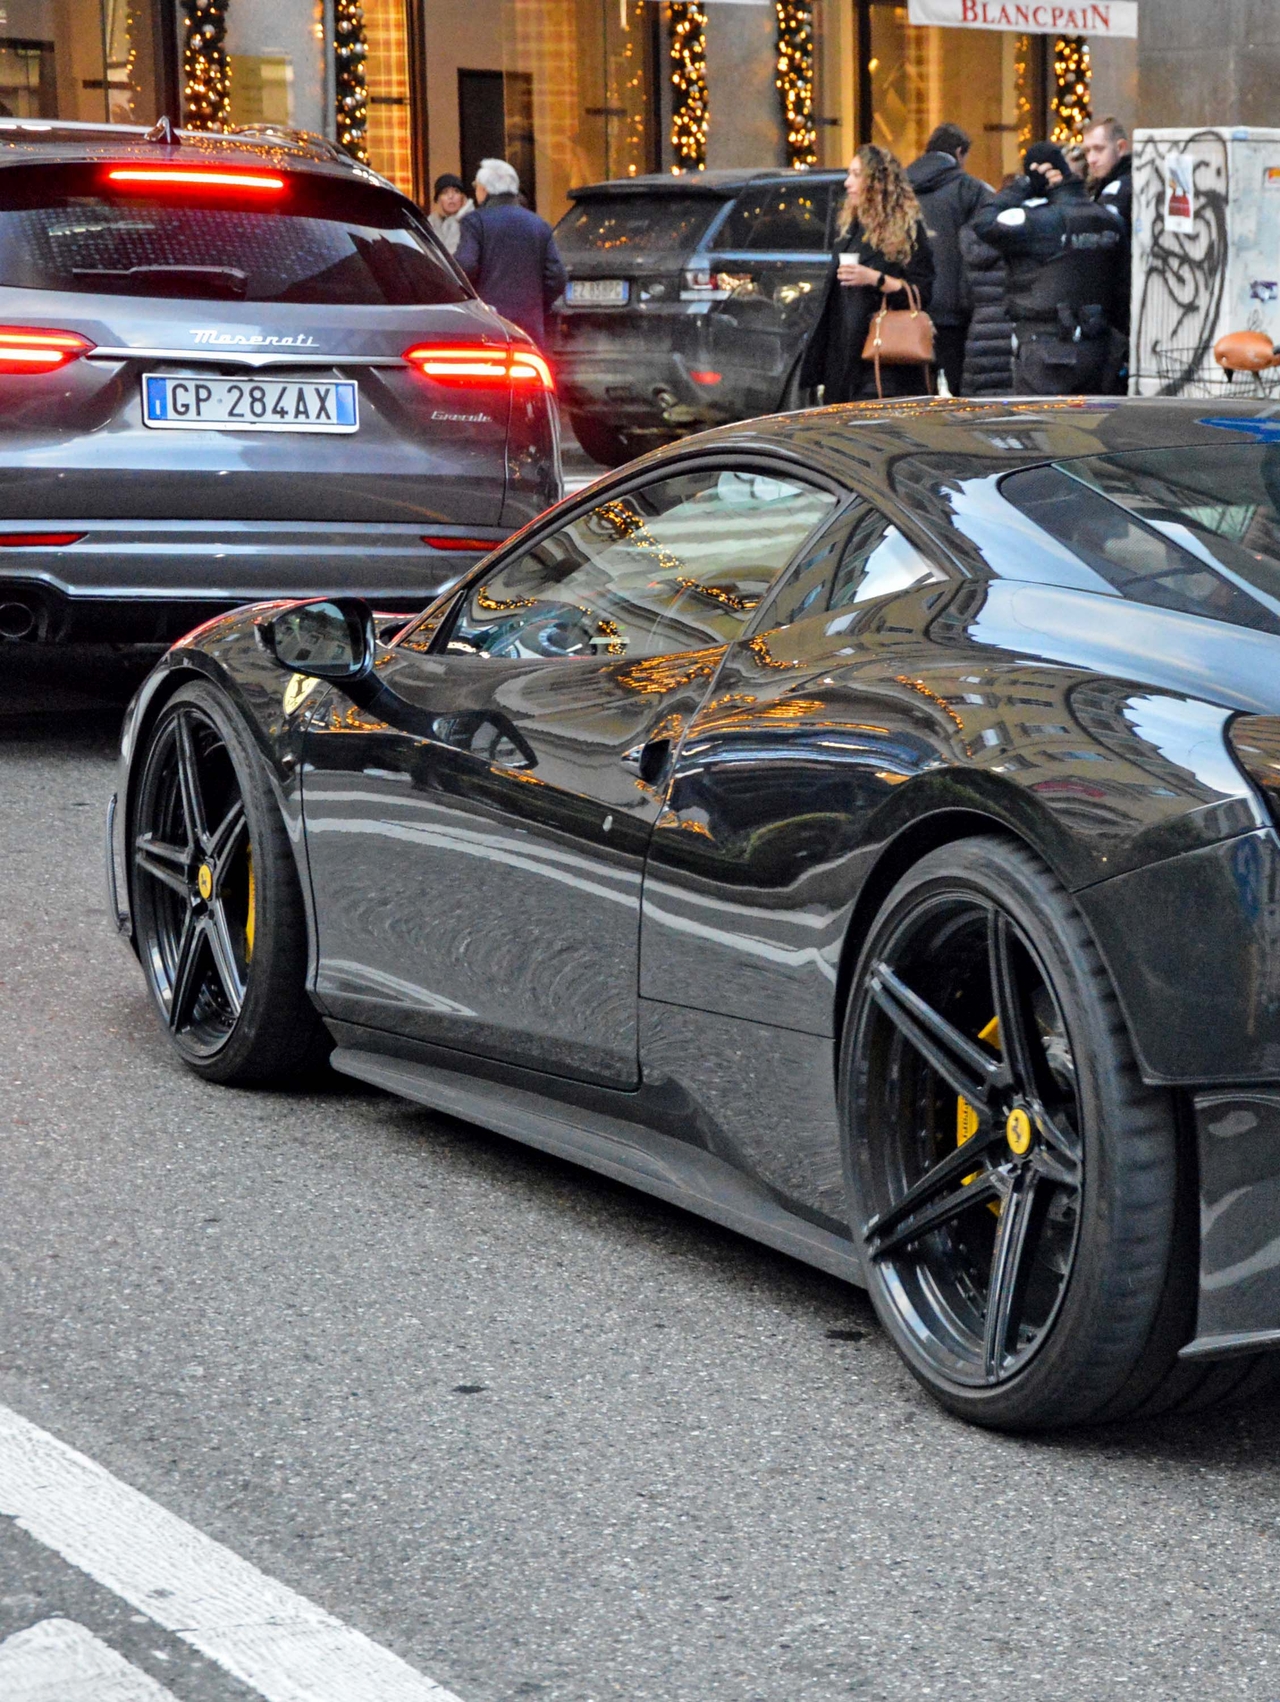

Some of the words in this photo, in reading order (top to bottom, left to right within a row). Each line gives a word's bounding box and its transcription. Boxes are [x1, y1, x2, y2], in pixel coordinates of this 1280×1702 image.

[189, 329, 320, 347] Maserati
[171, 383, 212, 417] GP
[226, 385, 332, 420] 284AX
